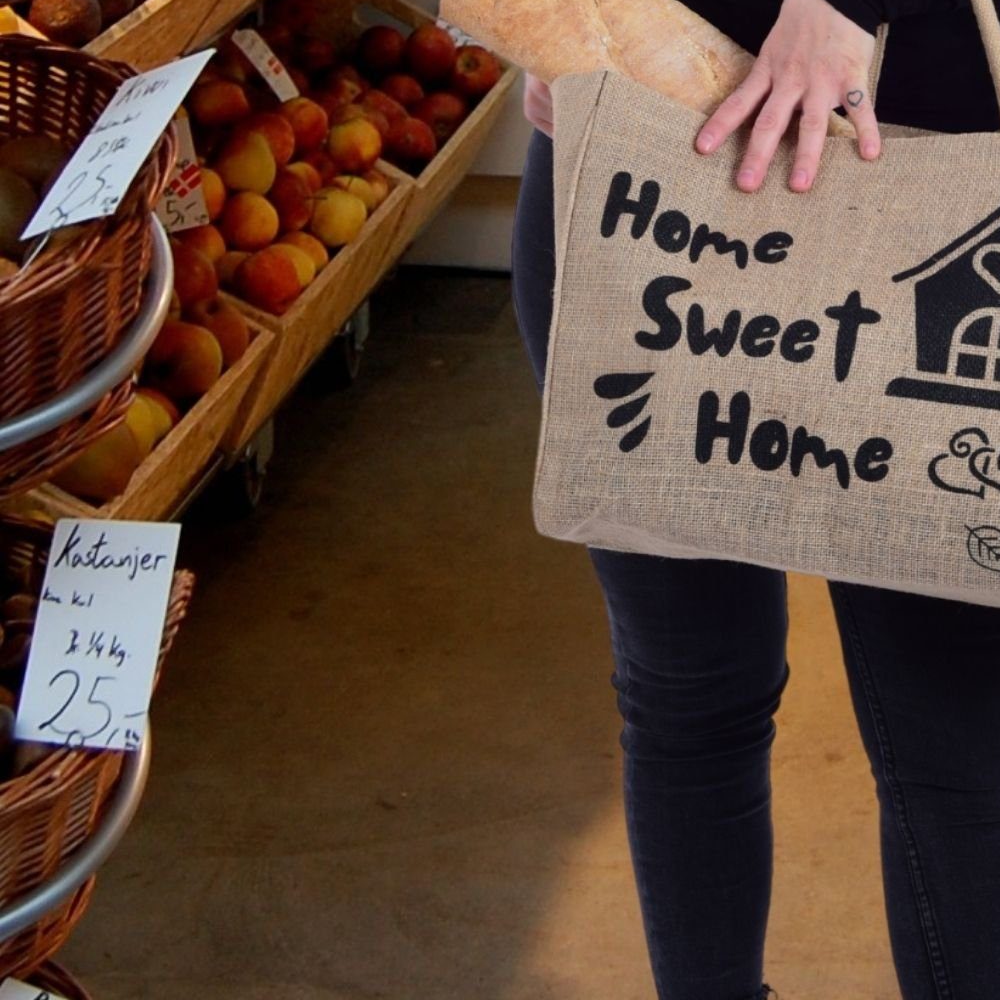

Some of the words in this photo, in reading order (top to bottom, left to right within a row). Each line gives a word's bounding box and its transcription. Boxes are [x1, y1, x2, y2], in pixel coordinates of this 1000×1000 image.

[600, 171, 794, 270] Home
[634, 275, 881, 383] Sweet
[694, 390, 894, 490] Home
[53, 523, 168, 581] Kastanjer
